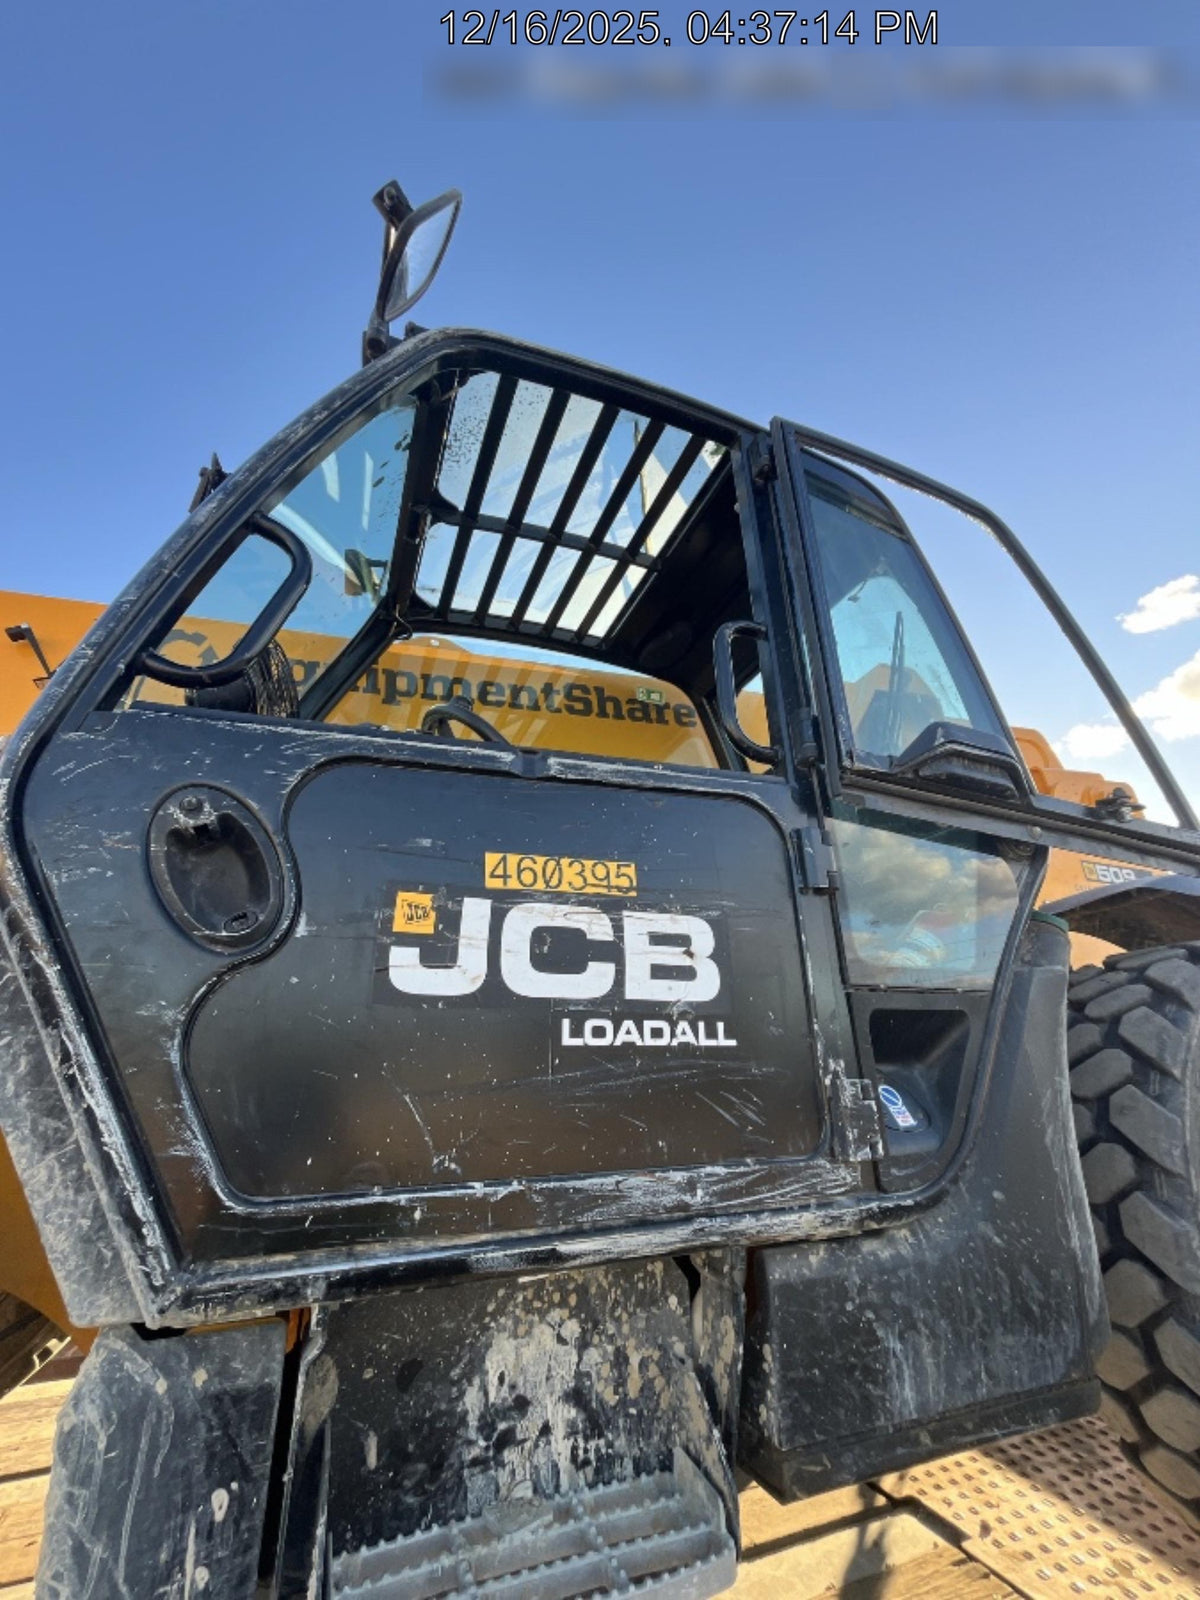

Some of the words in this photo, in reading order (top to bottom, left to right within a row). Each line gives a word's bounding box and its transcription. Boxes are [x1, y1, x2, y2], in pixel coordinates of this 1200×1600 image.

[489, 854, 634, 894] 460395
[388, 896, 721, 1002] JCB
[561, 1018, 738, 1046] LOADALL
